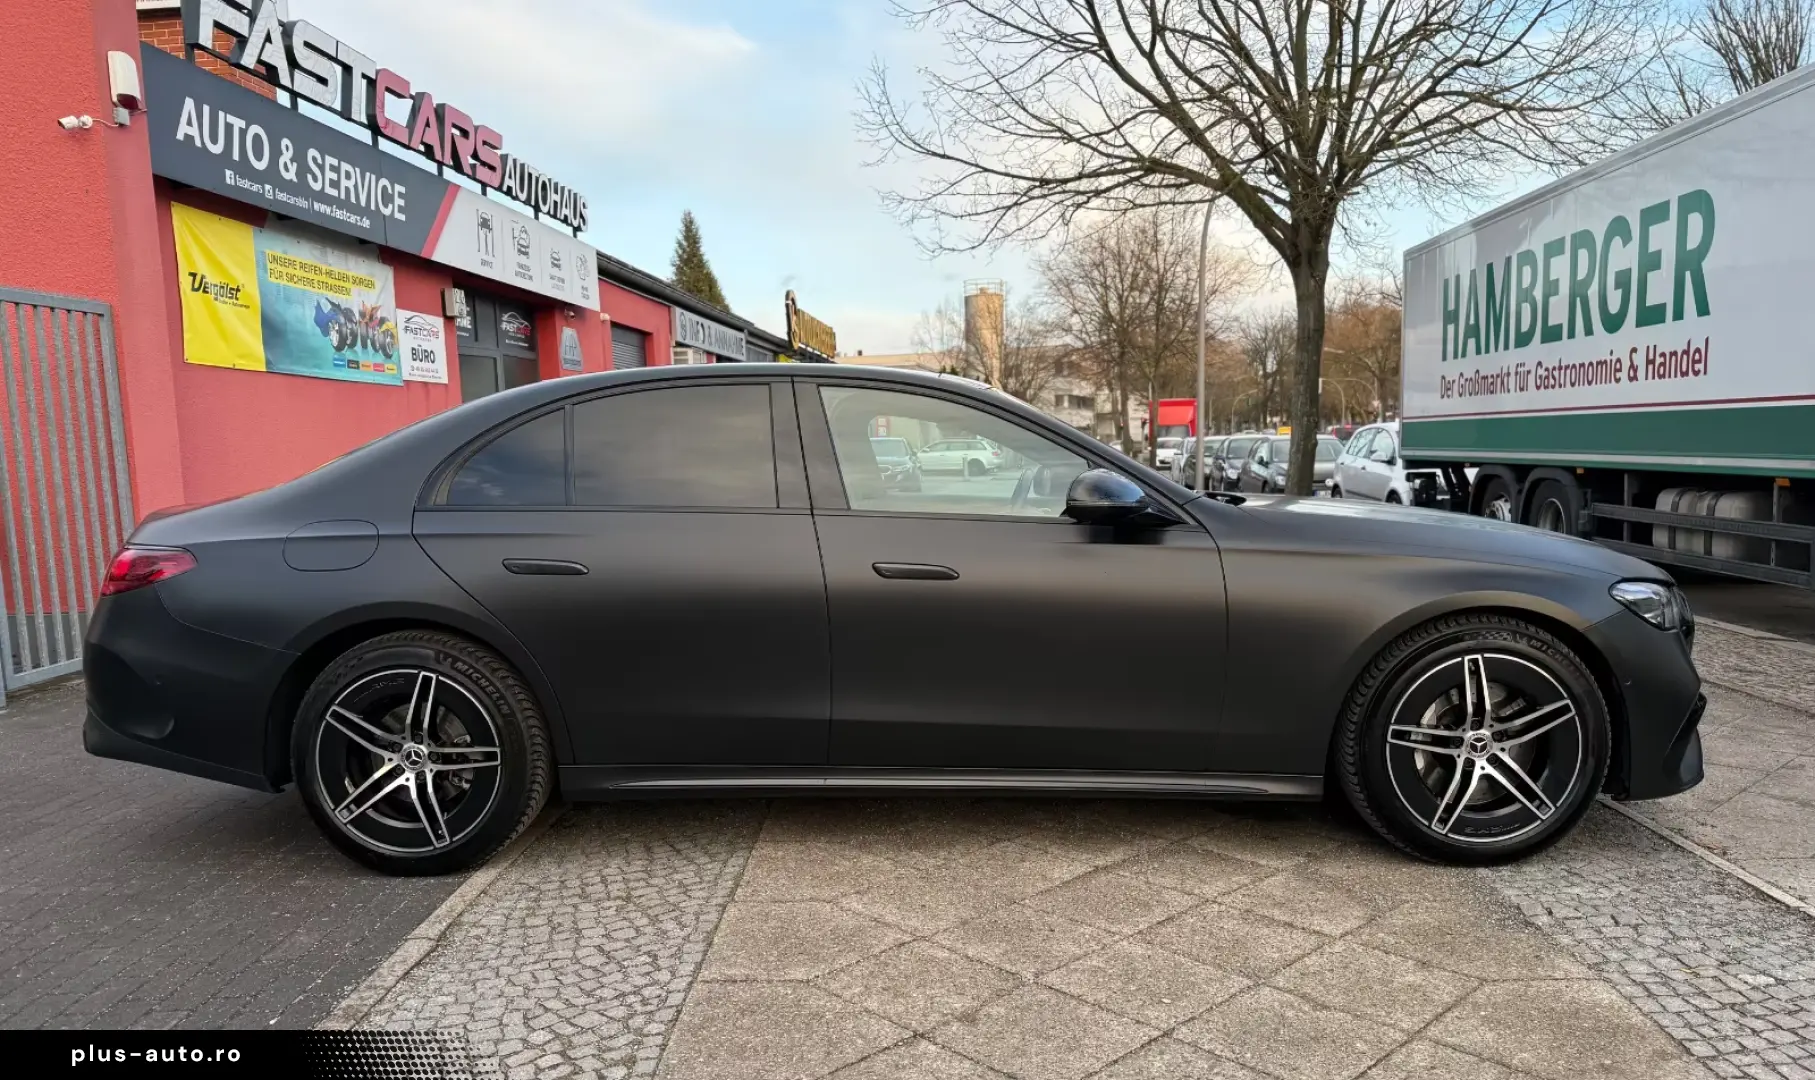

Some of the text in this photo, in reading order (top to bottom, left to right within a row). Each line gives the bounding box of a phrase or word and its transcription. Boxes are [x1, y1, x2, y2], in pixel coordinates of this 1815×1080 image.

[175, 95, 406, 222] AUTO & SERVICE
[235, 174, 263, 194] fastcars
[313, 200, 371, 229] www.fastcars.de
[502, 153, 589, 232] AUTOHAUS
[188, 271, 242, 302] Vergölst
[267, 252, 376, 290] UNSERE REIFEN-HELDEN SORGEN
[269, 267, 352, 297] FÜR SICHERE STRASSEN!
[1441, 188, 1716, 362] HAMBERGER
[410, 343, 436, 364] BÜRO
[1440, 336, 1710, 399] Der Großmarkt für Gastronomie & Handel
[454, 661, 511, 714] MICHELIN
